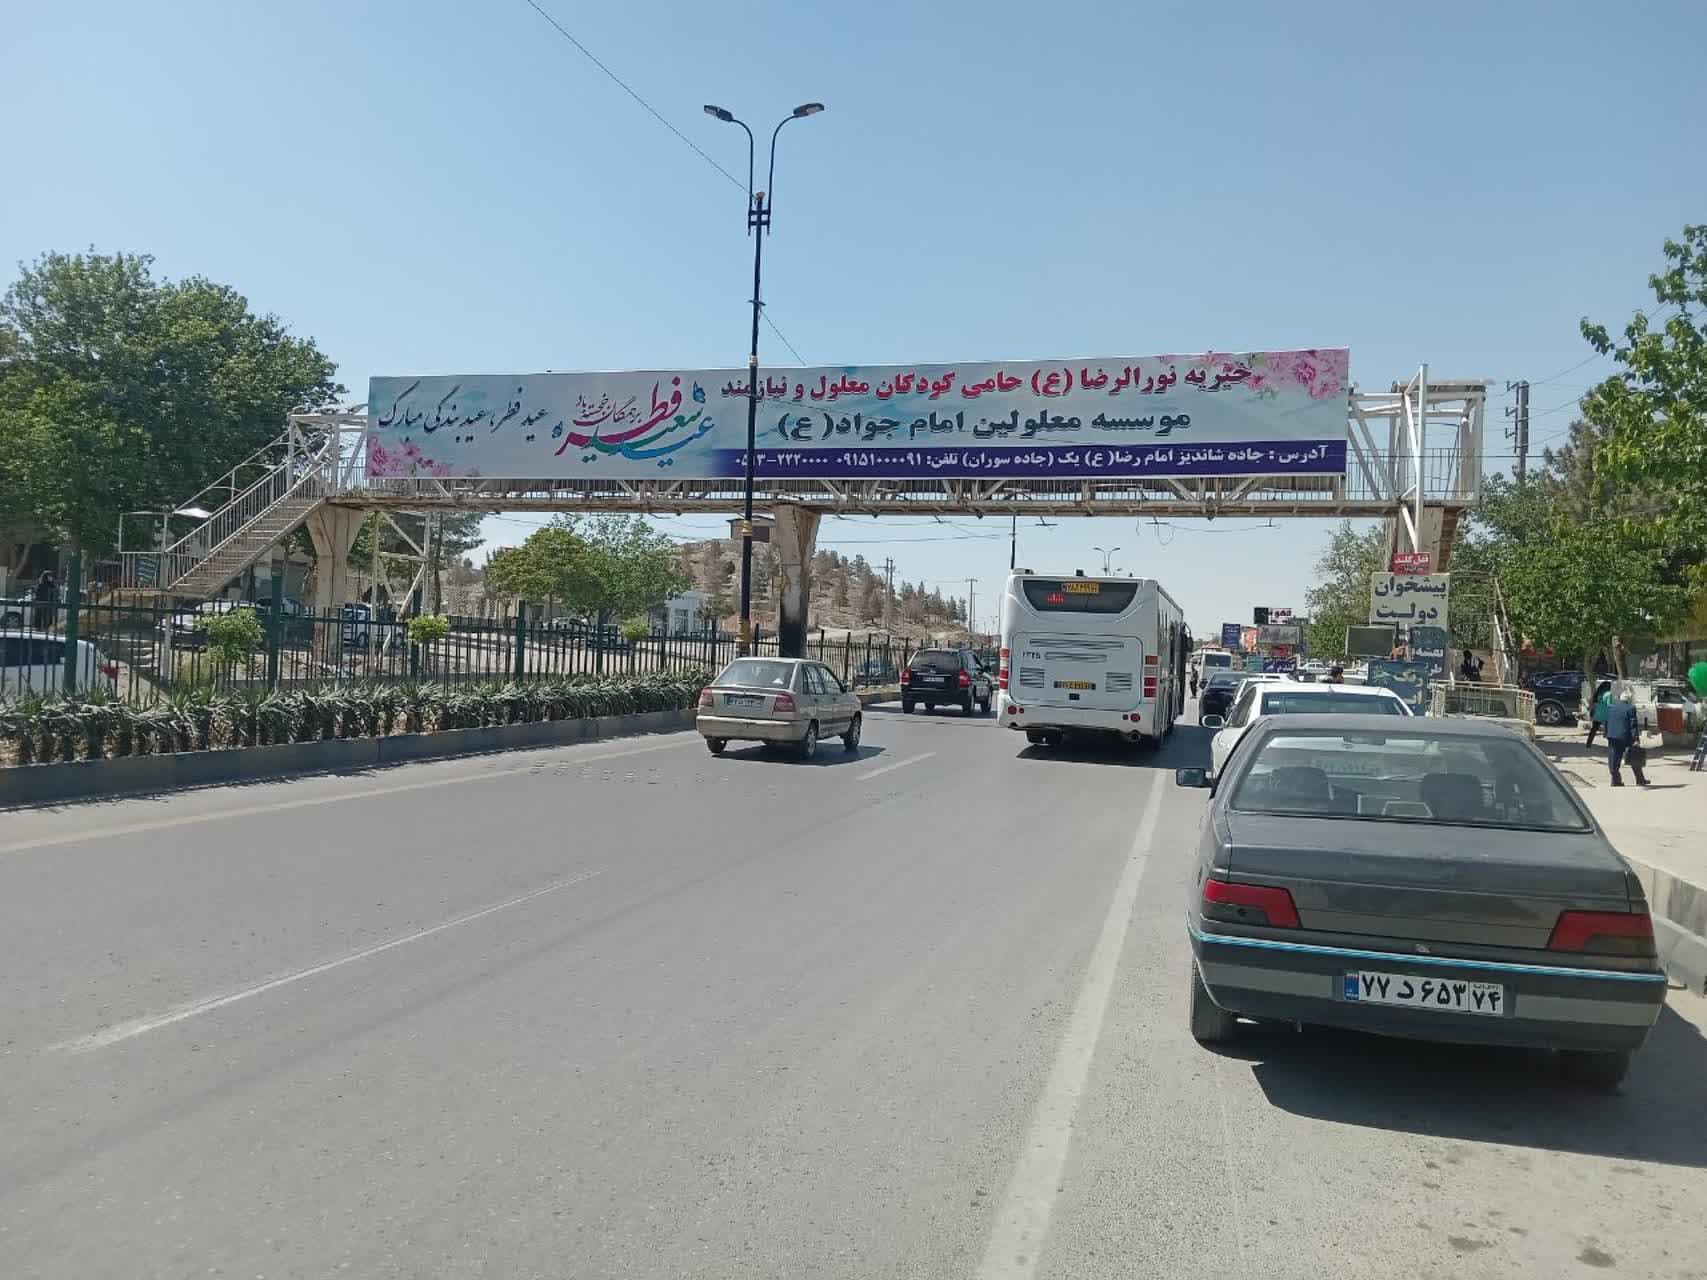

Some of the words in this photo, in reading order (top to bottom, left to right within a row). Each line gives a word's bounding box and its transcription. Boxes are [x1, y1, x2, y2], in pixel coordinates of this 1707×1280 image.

[792, 383, 804, 401] و
[810, 374, 870, 400] معلول
[876, 372, 956, 400] کودکان
[961, 370, 1022, 400] حامی
[378, 380, 423, 442] مبارک
[909, 411, 964, 437] امام
[971, 409, 1082, 439] معلولین
[1091, 411, 1191, 437] موسسه
[520, 408, 550, 442] عید
[1057, 451, 1080, 465] یک
[1144, 449, 1174, 467] امام
[1180, 446, 1224, 466] شاندیز
[1228, 448, 1265, 462] جاده
[1375, 576, 1447, 600] پیشخوان
[1376, 602, 1438, 624] دولت
